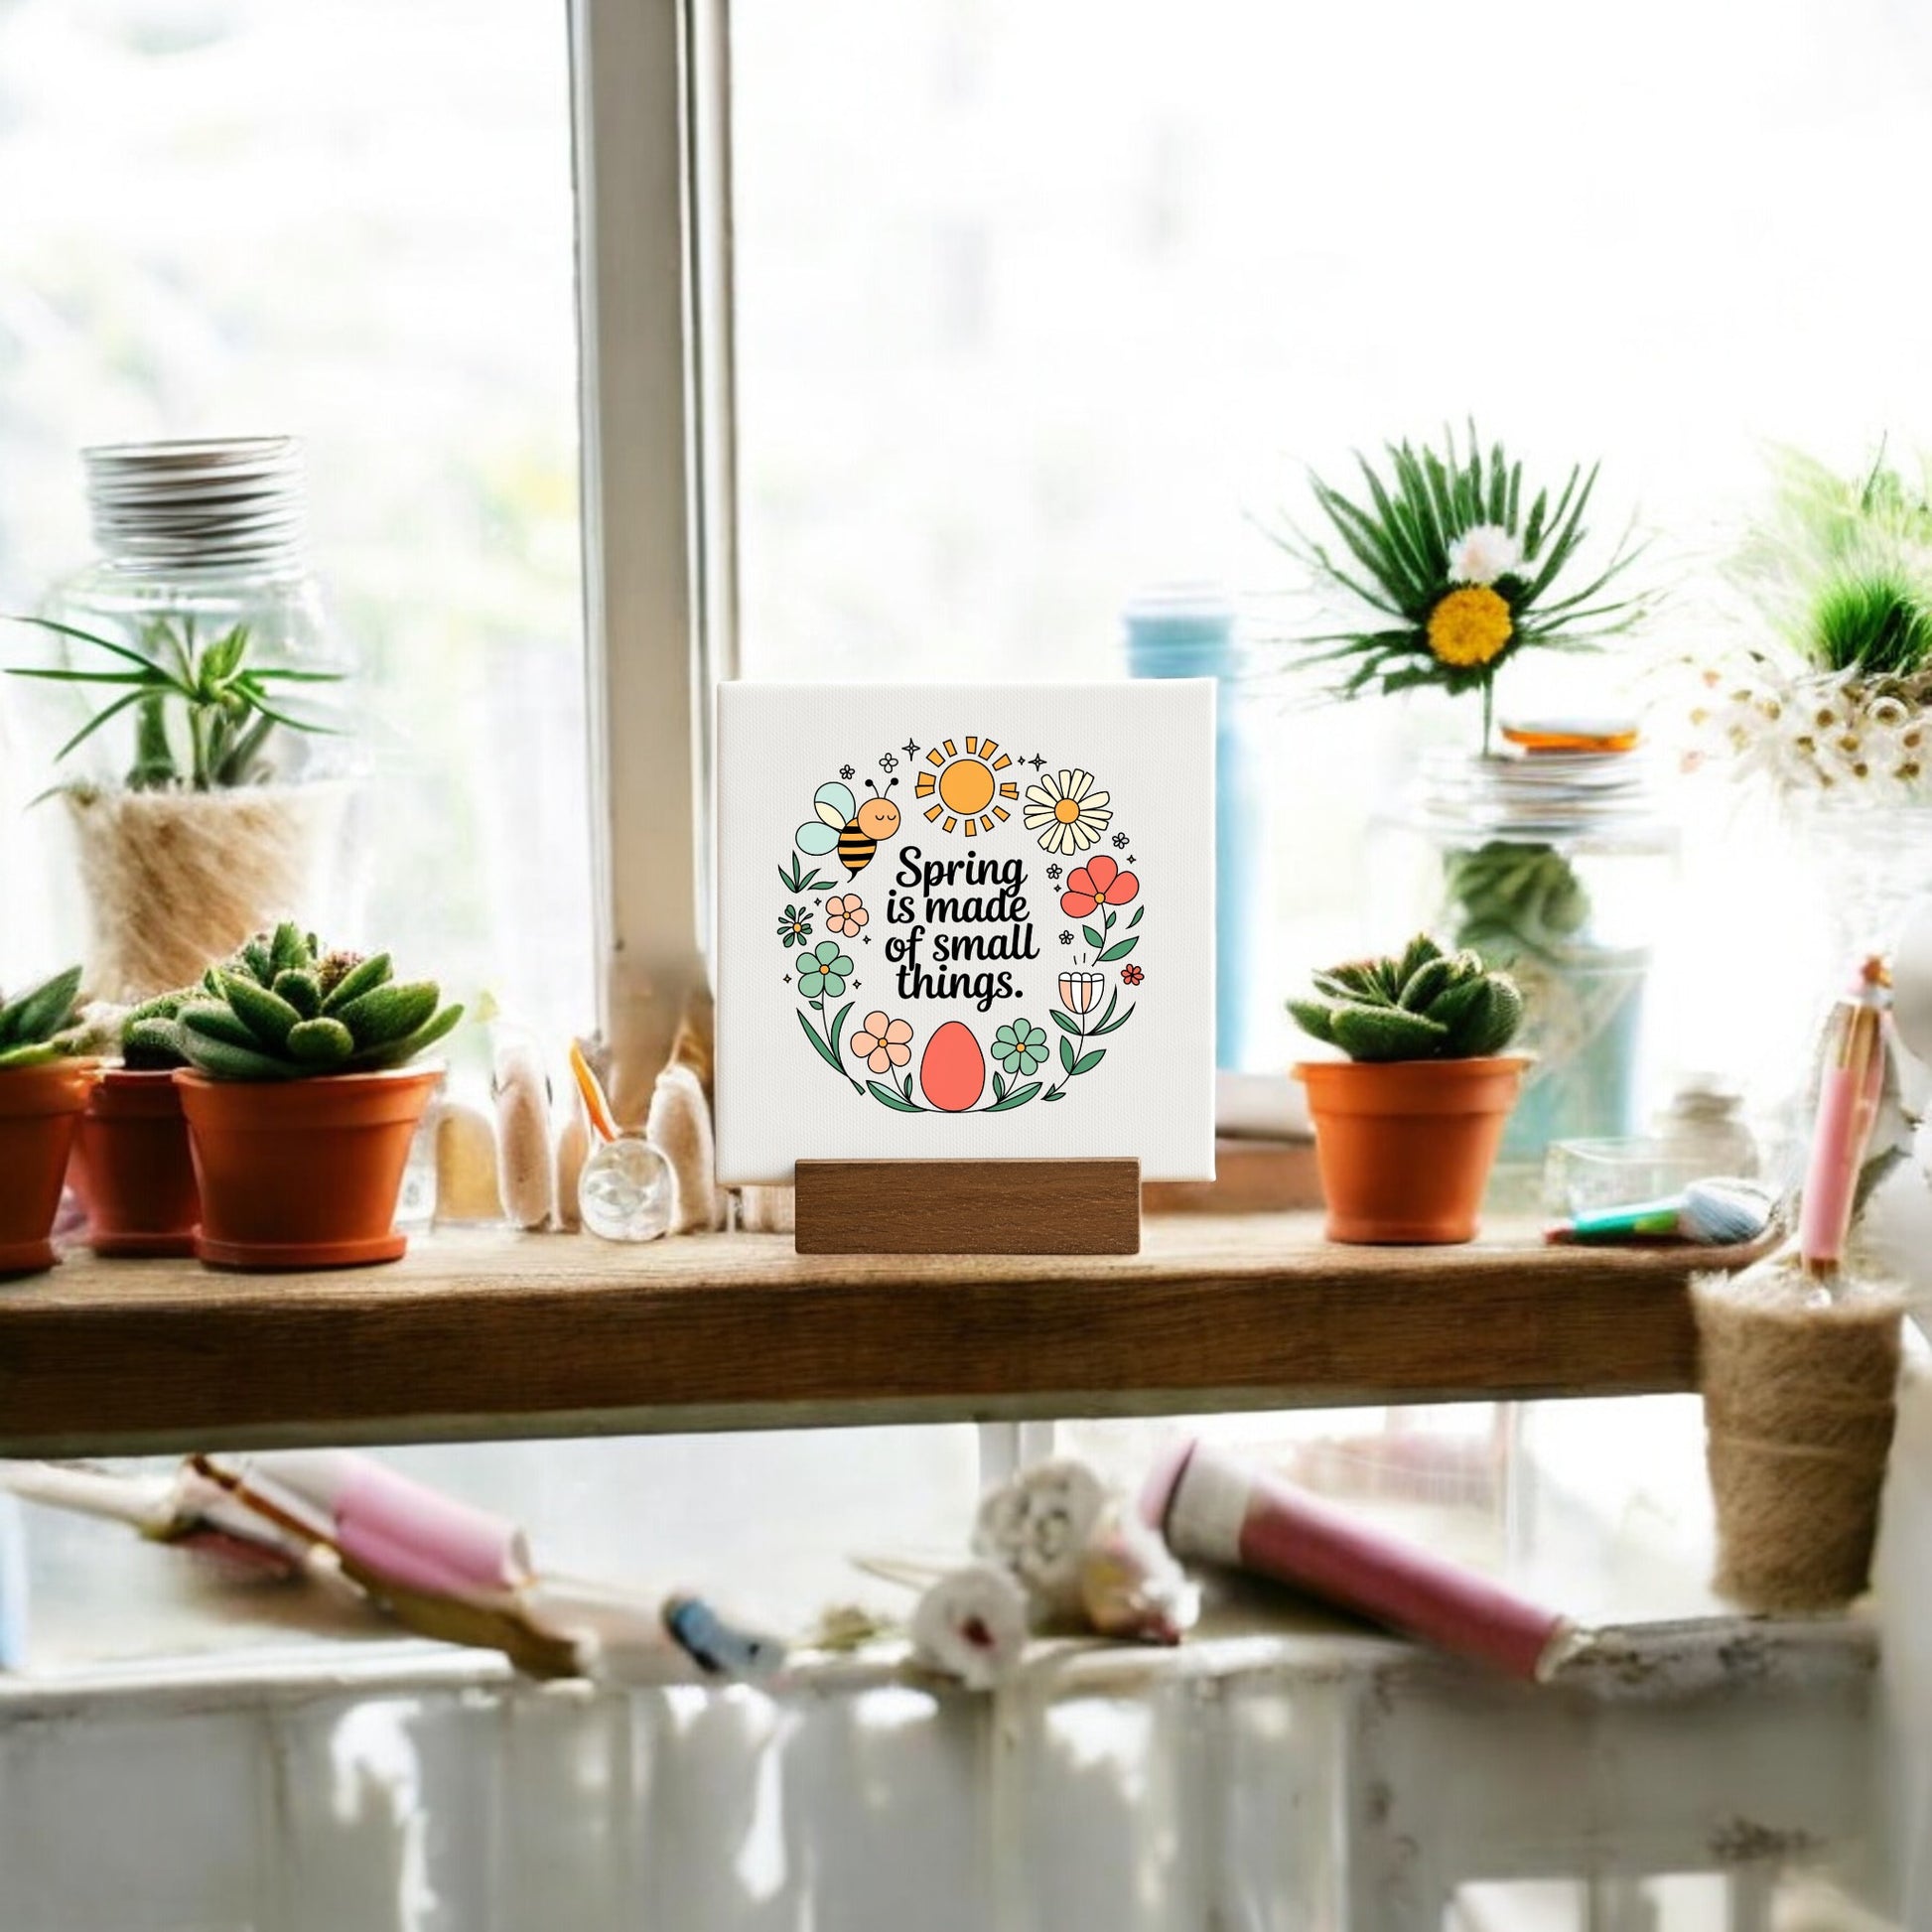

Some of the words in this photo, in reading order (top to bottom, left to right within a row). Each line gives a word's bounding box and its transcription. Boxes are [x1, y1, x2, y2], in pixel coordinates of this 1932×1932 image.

[896, 845, 1029, 898] Spring
[887, 889, 915, 924] is
[925, 888, 1031, 923] made
[885, 924, 926, 972] of
[932, 922, 1040, 962] small
[896, 962, 1024, 1013] things.
